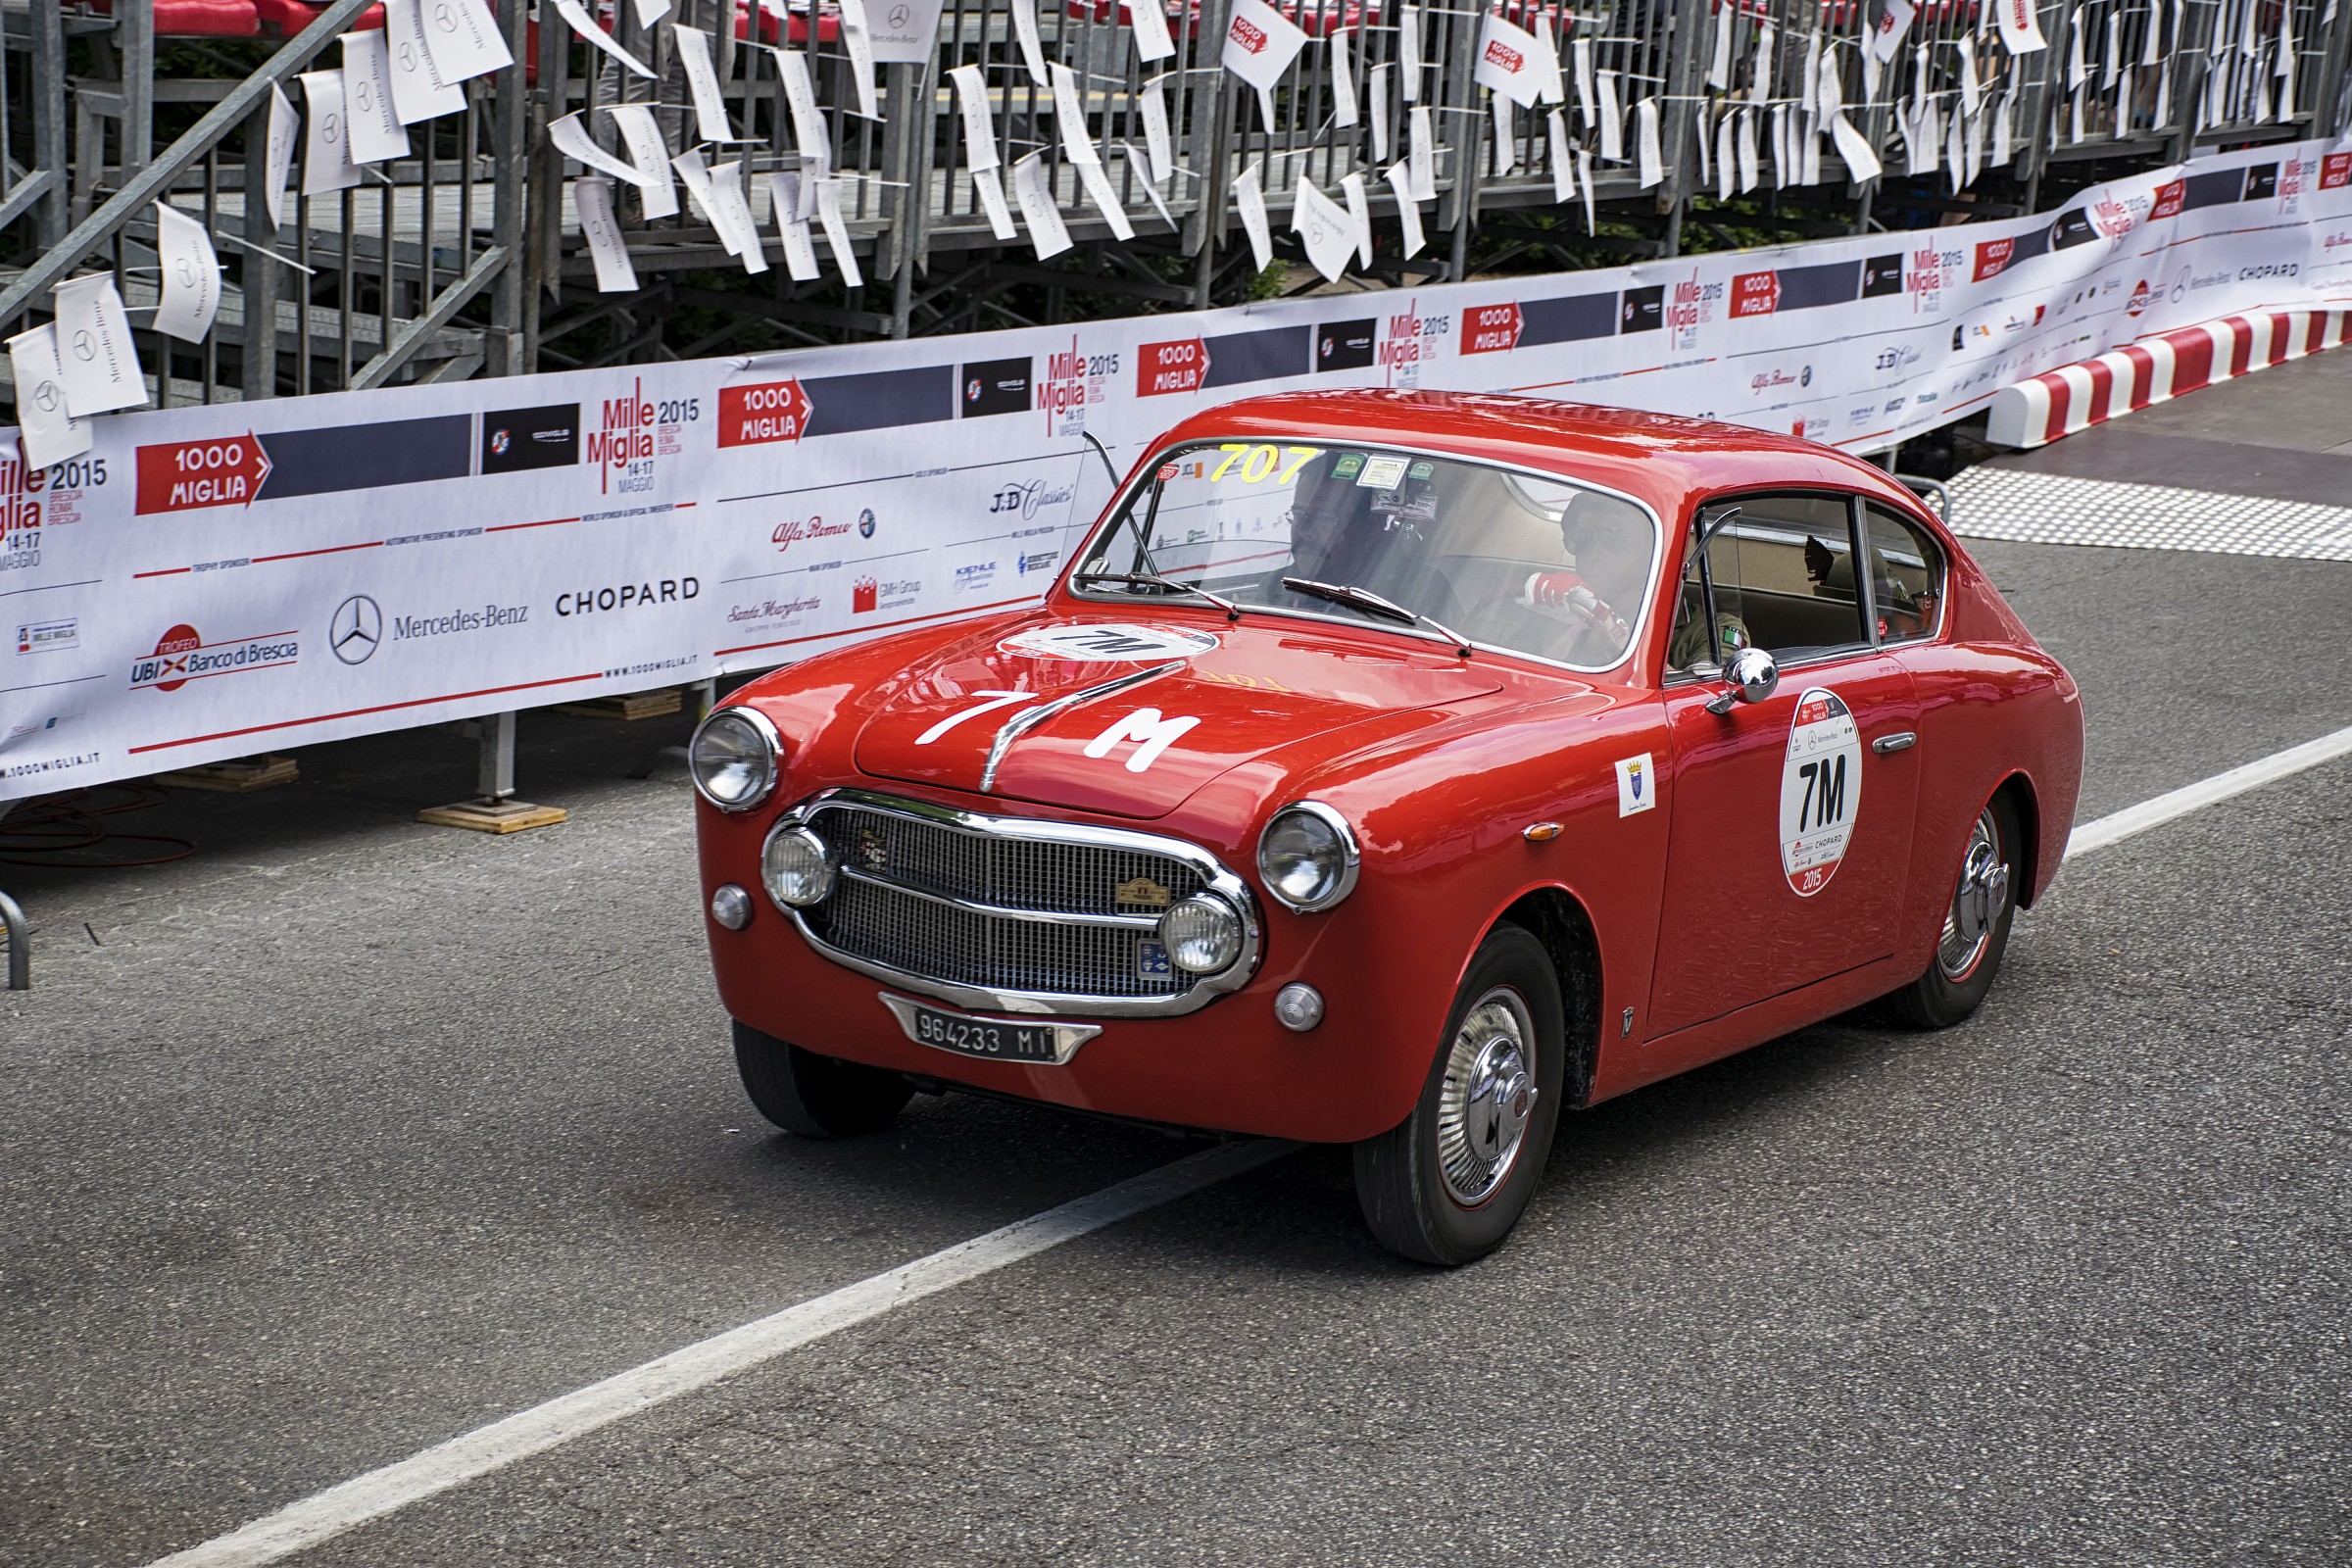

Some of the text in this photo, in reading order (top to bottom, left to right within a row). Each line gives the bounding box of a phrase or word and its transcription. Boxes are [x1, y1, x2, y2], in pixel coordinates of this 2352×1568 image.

[1236, 19, 1262, 40] 1000
[1491, 42, 1518, 61] 1000
[1744, 275, 1771, 293] 1000
[2238, 263, 2299, 281] CHOPARD
[1389, 298, 1421, 340] Mille
[1423, 316, 1449, 336] 2015
[1478, 308, 1512, 326] 1000
[92, 300, 122, 383] Mercedes-Benz
[1474, 330, 1512, 350] MIGLIA
[1048, 333, 1086, 381] Mille
[1088, 353, 1119, 376] 2015
[1157, 344, 1196, 366] 1000
[1378, 338, 1419, 388] Miglia
[1153, 368, 1197, 391] MIGLIA
[603, 375, 656, 431] Mille
[658, 398, 700, 425] 2015
[743, 386, 792, 411] 1000
[1037, 379, 1086, 438] Miglia
[741, 415, 796, 440] MIGLIA
[0, 436, 46, 494] ille
[174, 443, 244, 472] 1000
[587, 428, 655, 495] Miglia
[626, 461, 655, 477] 14-17
[1209, 444, 1318, 485] 707
[50, 459, 107, 490] 2015
[170, 475, 247, 506] MIGLIA
[5, 532, 42, 551] 14-17
[771, 515, 853, 552] Alfa Romeo
[556, 576, 699, 616] CHOPARD
[392, 604, 529, 641] Mercedes-Benz
[727, 604, 760, 623] Santa
[158, 637, 197, 655] TROFEO
[130, 640, 298, 683] UBI Banco di Brescia
[914, 690, 1201, 772] 7 M
[1799, 754, 1846, 833] 7M
[1815, 834, 1842, 849] CHOPARD
[1802, 867, 1823, 891] 2015
[920, 1014, 1001, 1053] 964233
